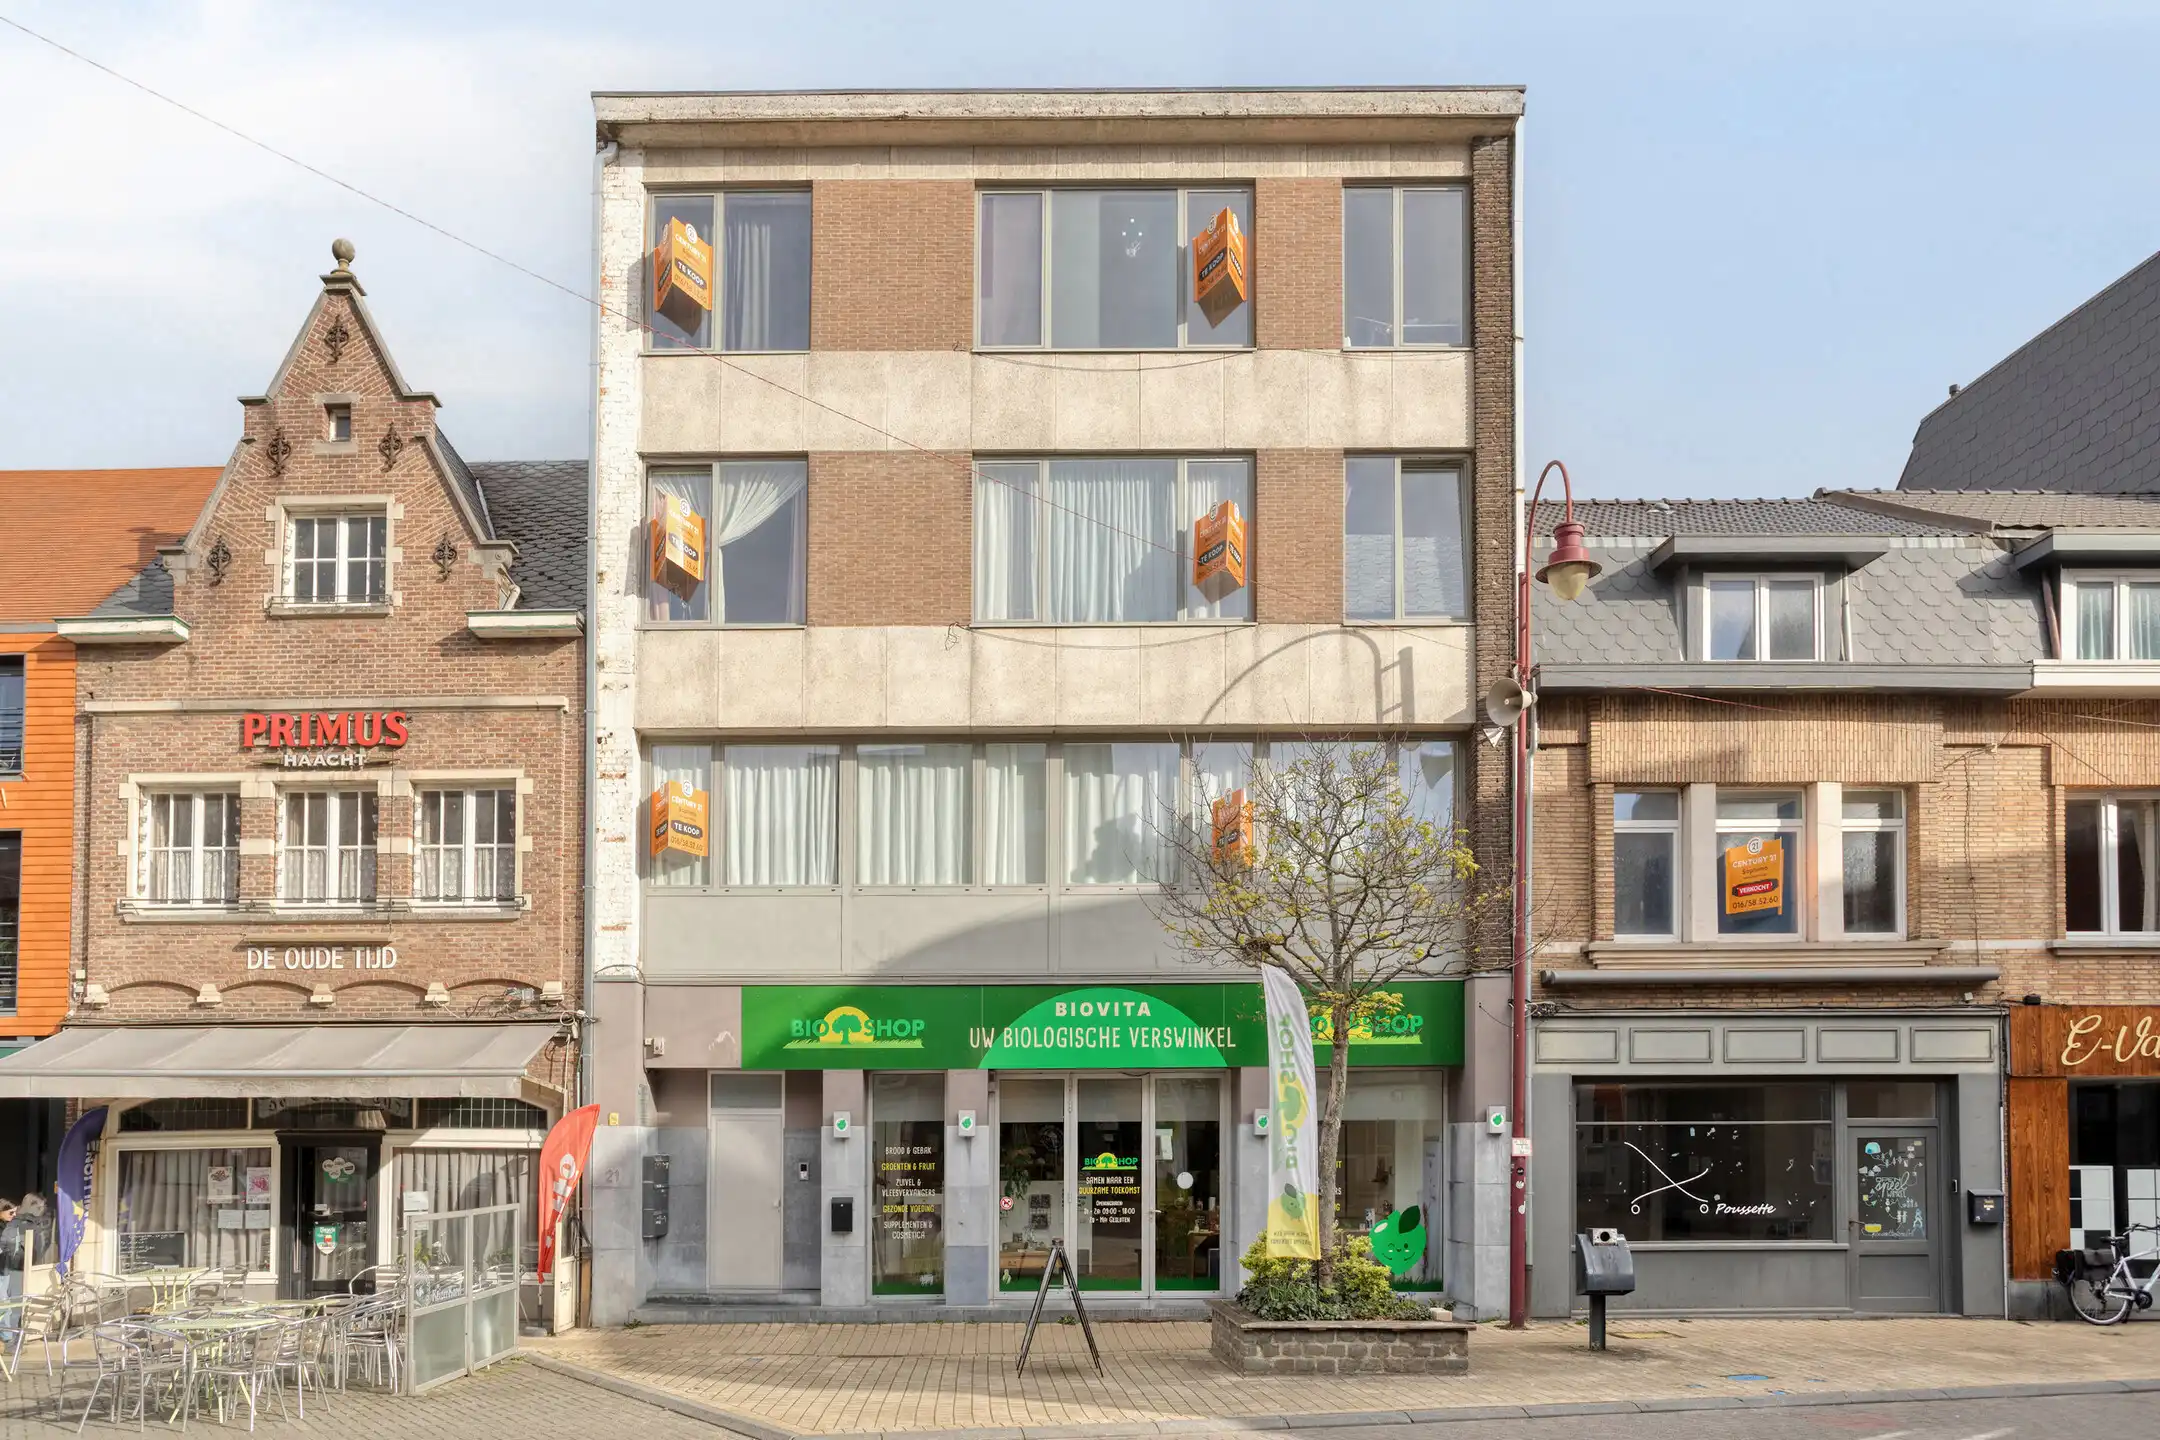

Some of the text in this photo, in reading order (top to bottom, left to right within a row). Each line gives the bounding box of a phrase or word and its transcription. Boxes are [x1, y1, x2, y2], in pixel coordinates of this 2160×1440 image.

[687, 268, 704, 286] KOOP
[242, 711, 409, 748] PRIMUS
[283, 753, 367, 767] HAACHT
[674, 822, 700, 836] TE KOOP
[1732, 856, 1767, 868] CENTURY
[1739, 883, 1770, 894] VERKOCHT
[247, 946, 398, 970] DE OUDE TIJD
[1055, 1001, 1152, 1017] BIOVITA
[791, 1018, 925, 1037] BIO SHOP
[969, 1026, 1236, 1048] UW BIOLOGISCHE VERSWINKEL
[885, 1146, 905, 1155] BROOD
[912, 1146, 932, 1155] GEBAK
[881, 1162, 911, 1171] GROENTEN
[918, 1162, 936, 1170] FRUIT
[1084, 1157, 1138, 1166] BIO SHOP
[605, 1168, 620, 1183] 21
[1086, 1176, 1134, 1184] SAMEN NAAR EEN
[895, 1178, 915, 1187] ZUIVEL
[881, 1188, 936, 1197] VLEESVERVANGERS
[1079, 1186, 1140, 1195] DUURZAME TOEKOMST
[882, 1204, 935, 1213] GEZONDE VOEDING
[1715, 1203, 1777, 1215] Poussette
[883, 1220, 927, 1229] SUPPLEMENTEN
[891, 1231, 926, 1240] COSMETICA
